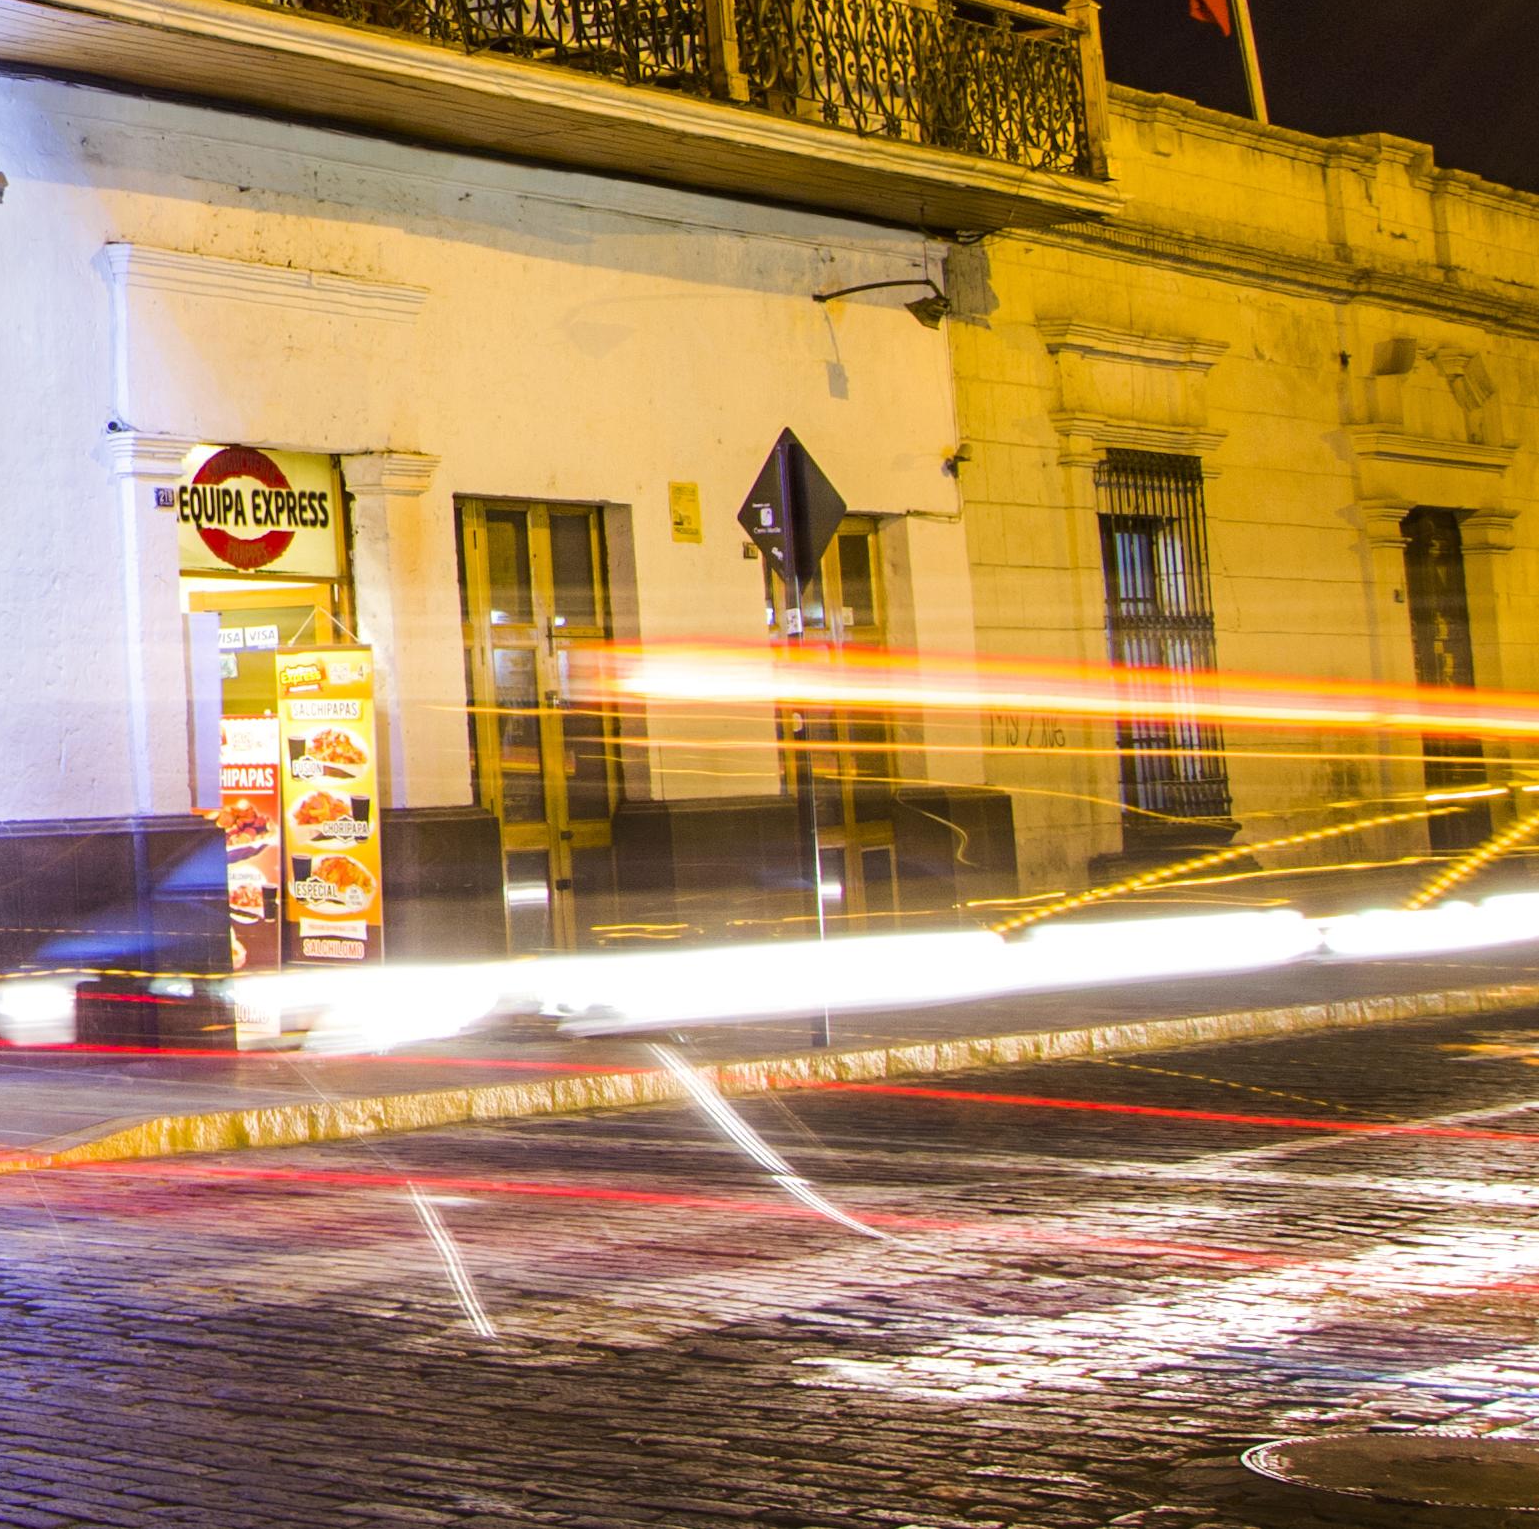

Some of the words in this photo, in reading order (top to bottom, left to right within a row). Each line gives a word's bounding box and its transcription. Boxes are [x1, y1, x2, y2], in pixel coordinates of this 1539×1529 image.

[177, 485, 247, 530] EQUIPA
[251, 488, 329, 529] EXPRESS
[249, 630, 276, 642] VISA
[293, 702, 358, 718] SALCHIPAPAS
[322, 821, 368, 835] CHORIPAPA
[296, 884, 338, 898] ESPECIAL
[303, 939, 364, 959] SALCHILOMO
